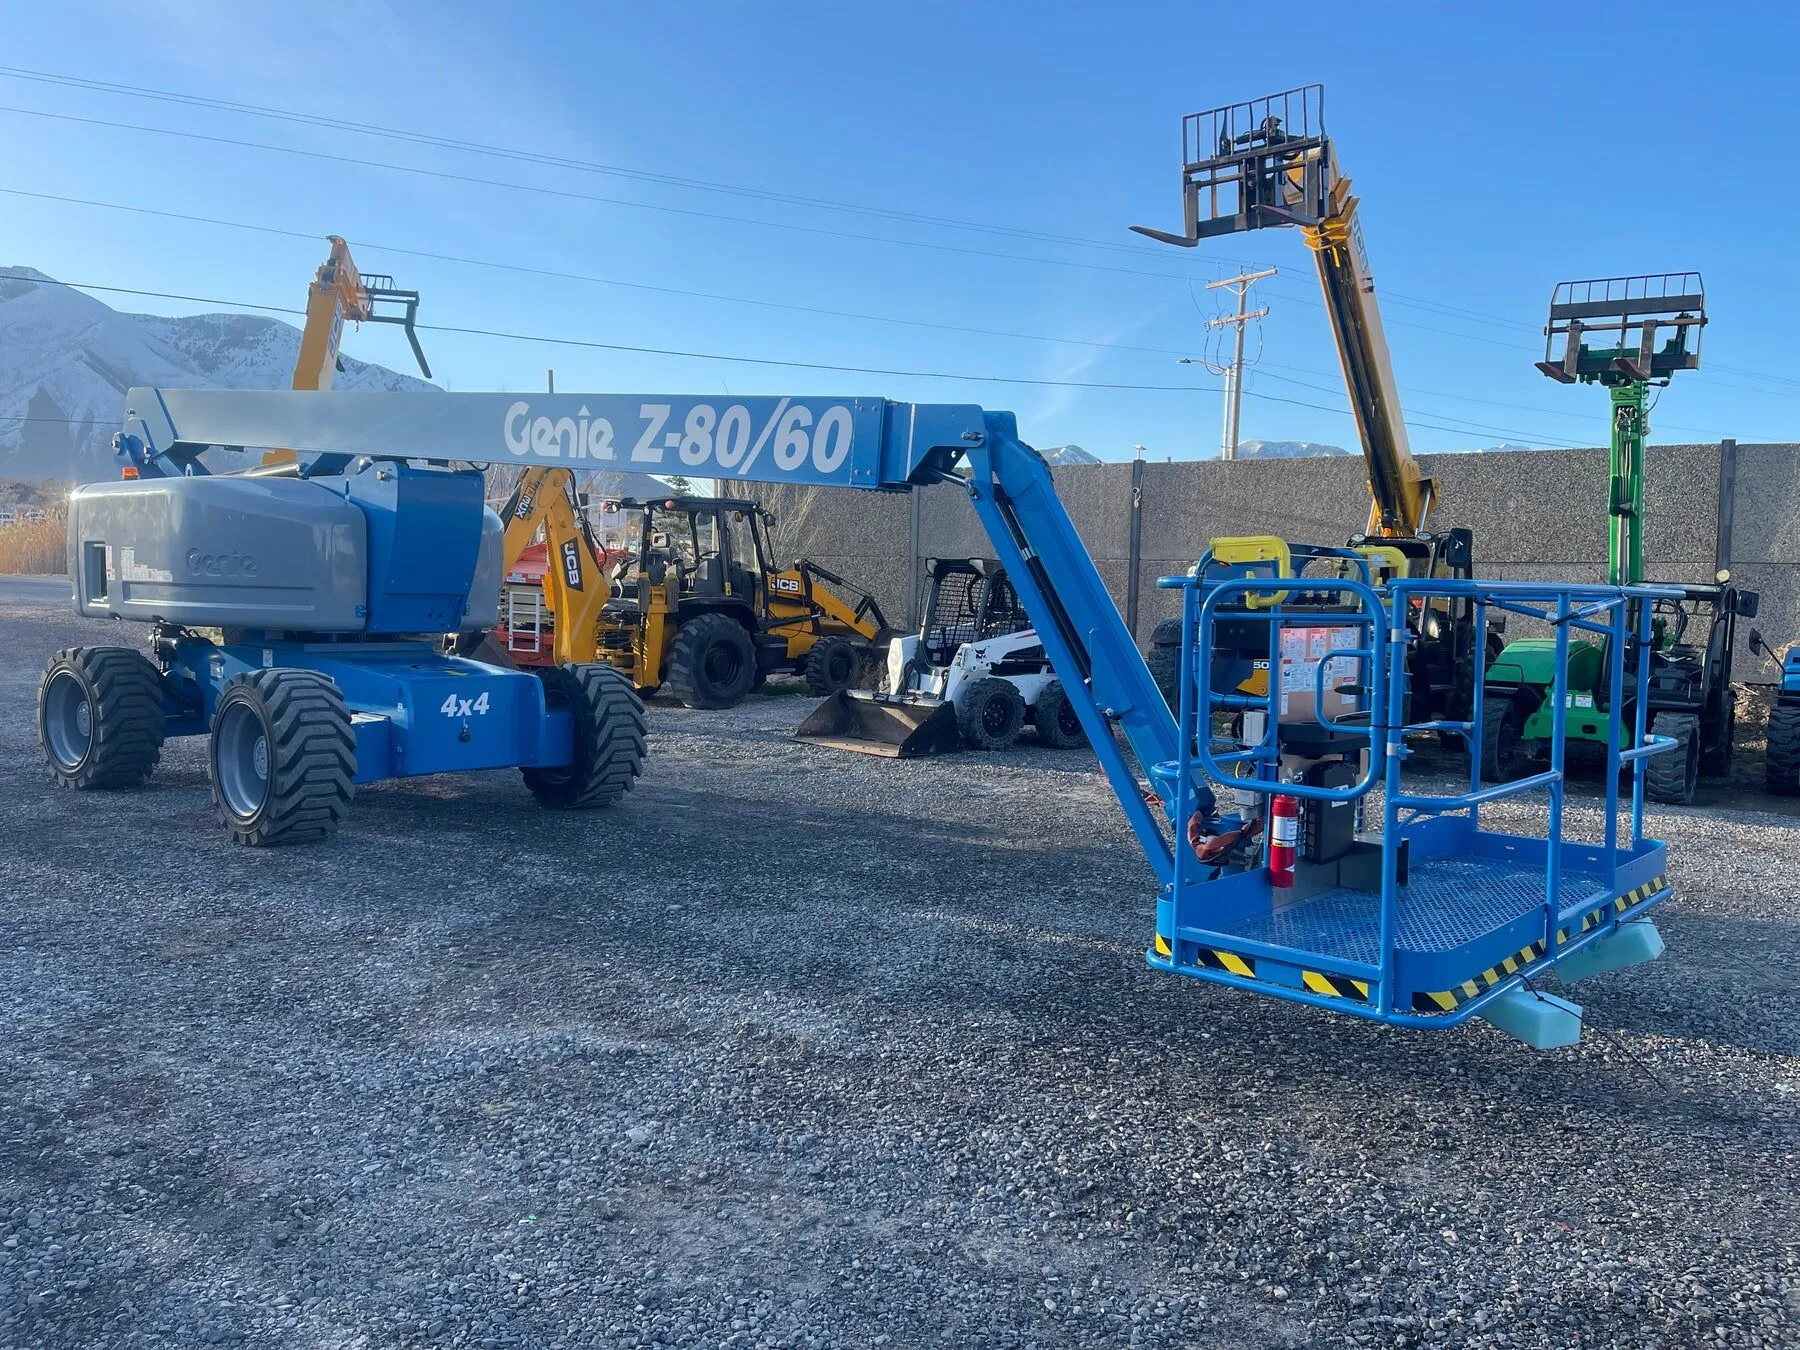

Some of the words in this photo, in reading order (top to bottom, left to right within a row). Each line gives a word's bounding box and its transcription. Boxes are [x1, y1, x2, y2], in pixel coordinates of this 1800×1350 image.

[504, 401, 614, 460] Genie
[630, 398, 852, 475] Z-80/60
[185, 547, 259, 577] Genie
[564, 543, 579, 585] JCB
[440, 692, 490, 717] 4x4
